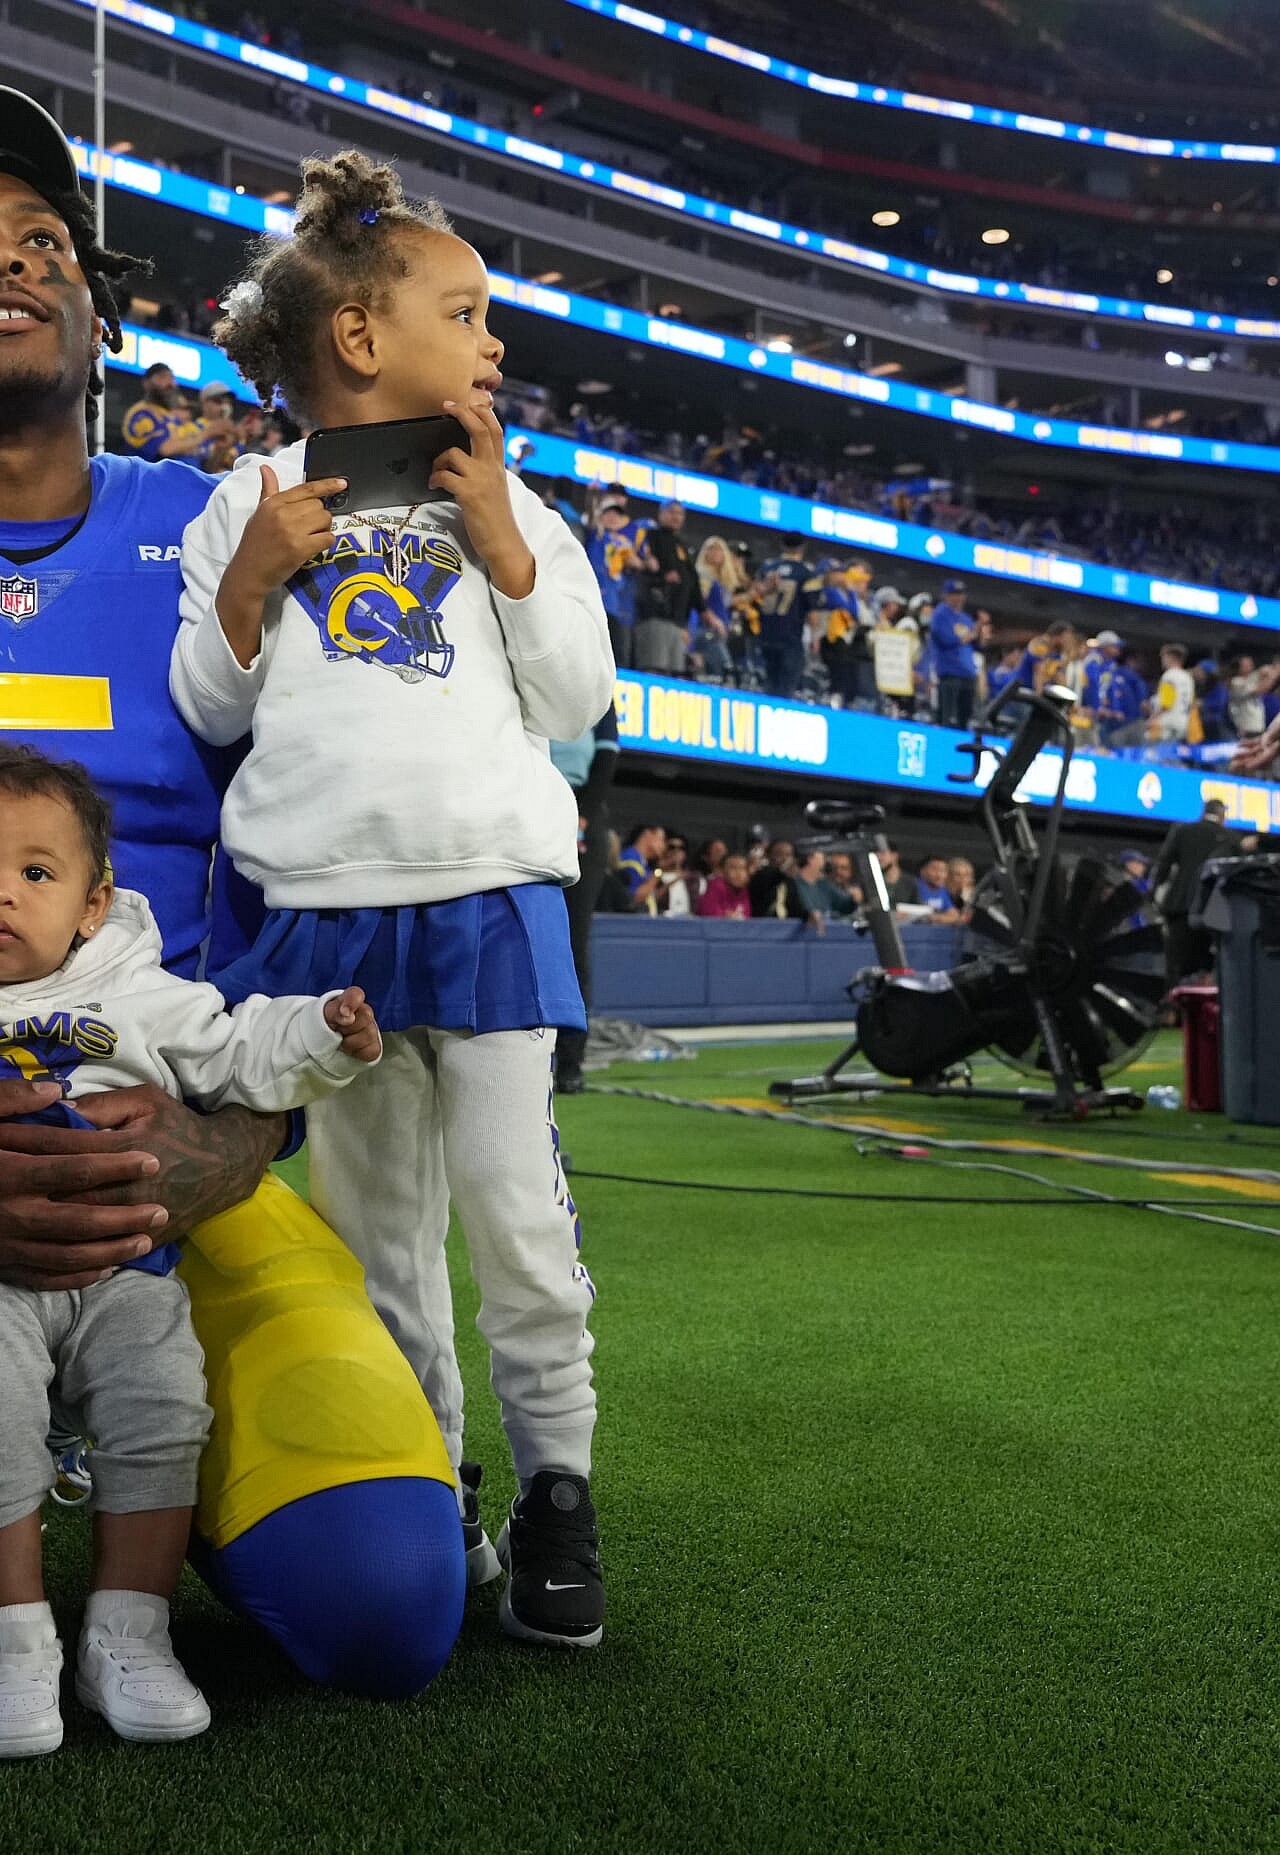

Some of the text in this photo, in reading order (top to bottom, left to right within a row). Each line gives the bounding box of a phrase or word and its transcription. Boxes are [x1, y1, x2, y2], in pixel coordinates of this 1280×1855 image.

[303, 529, 464, 576] AMS
[3, 593, 32, 612] NFL
[648, 685, 717, 749] BOWL
[721, 698, 755, 754] LVI
